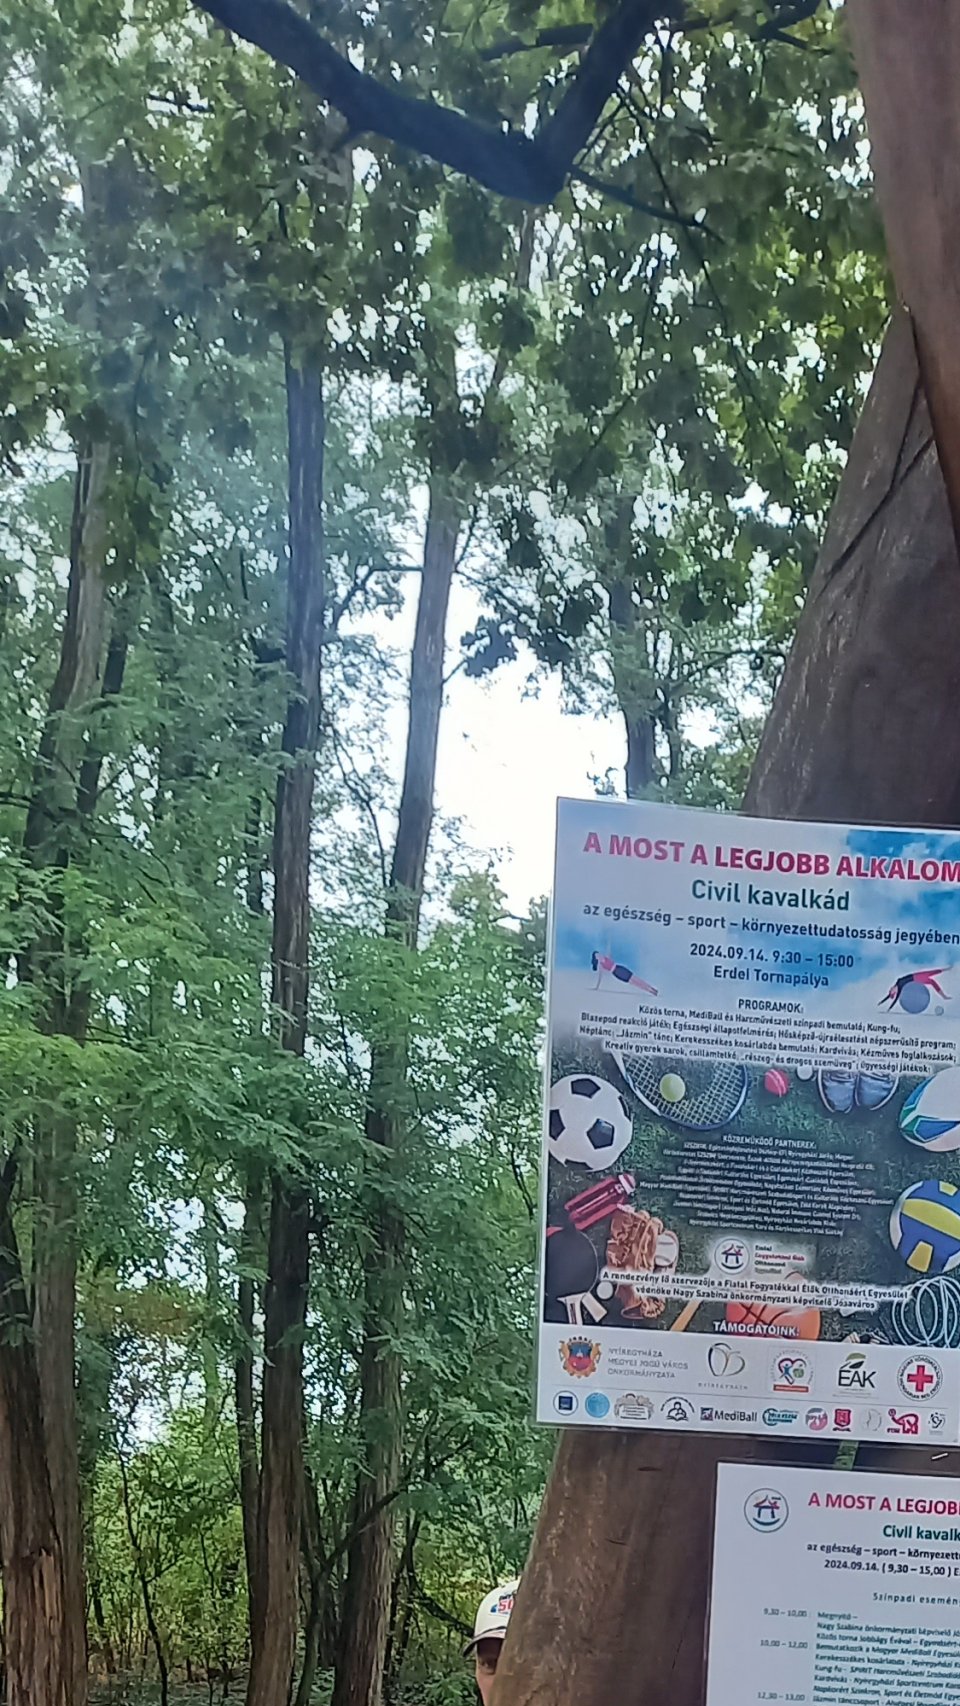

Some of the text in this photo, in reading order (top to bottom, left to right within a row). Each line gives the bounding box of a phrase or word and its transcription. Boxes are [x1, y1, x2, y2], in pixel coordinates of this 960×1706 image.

[583, 831, 602, 853] A
[609, 834, 684, 862] MOST
[690, 843, 708, 865] A
[715, 845, 830, 876] LEGJOBB
[692, 879, 849, 912] Civil kavalkád
[583, 904, 599, 915] az
[603, 903, 671, 926] egészség
[687, 913, 725, 931] sport
[741, 915, 892, 945] környezettudatosság
[894, 926, 960, 949] jegyében
[690, 942, 768, 962] 2024.09.14.
[772, 950, 801, 964] 9:30
[817, 952, 853, 968] 15:00
[752, 968, 828, 988] Tornapálya
[611, 1272, 658, 1283] rendezvény
[673, 1288, 693, 1298] Nagy
[696, 1290, 727, 1299] Szabina
[793, 1295, 831, 1307] képviselő
[714, 1407, 757, 1423] MediBall
[808, 1492, 820, 1506] A
[825, 1493, 875, 1510] MOST
[879, 1497, 892, 1511] A
[882, 1524, 912, 1538] Civil
[807, 1543, 817, 1551] az
[820, 1542, 861, 1555] egészség
[872, 1546, 897, 1558] sport
